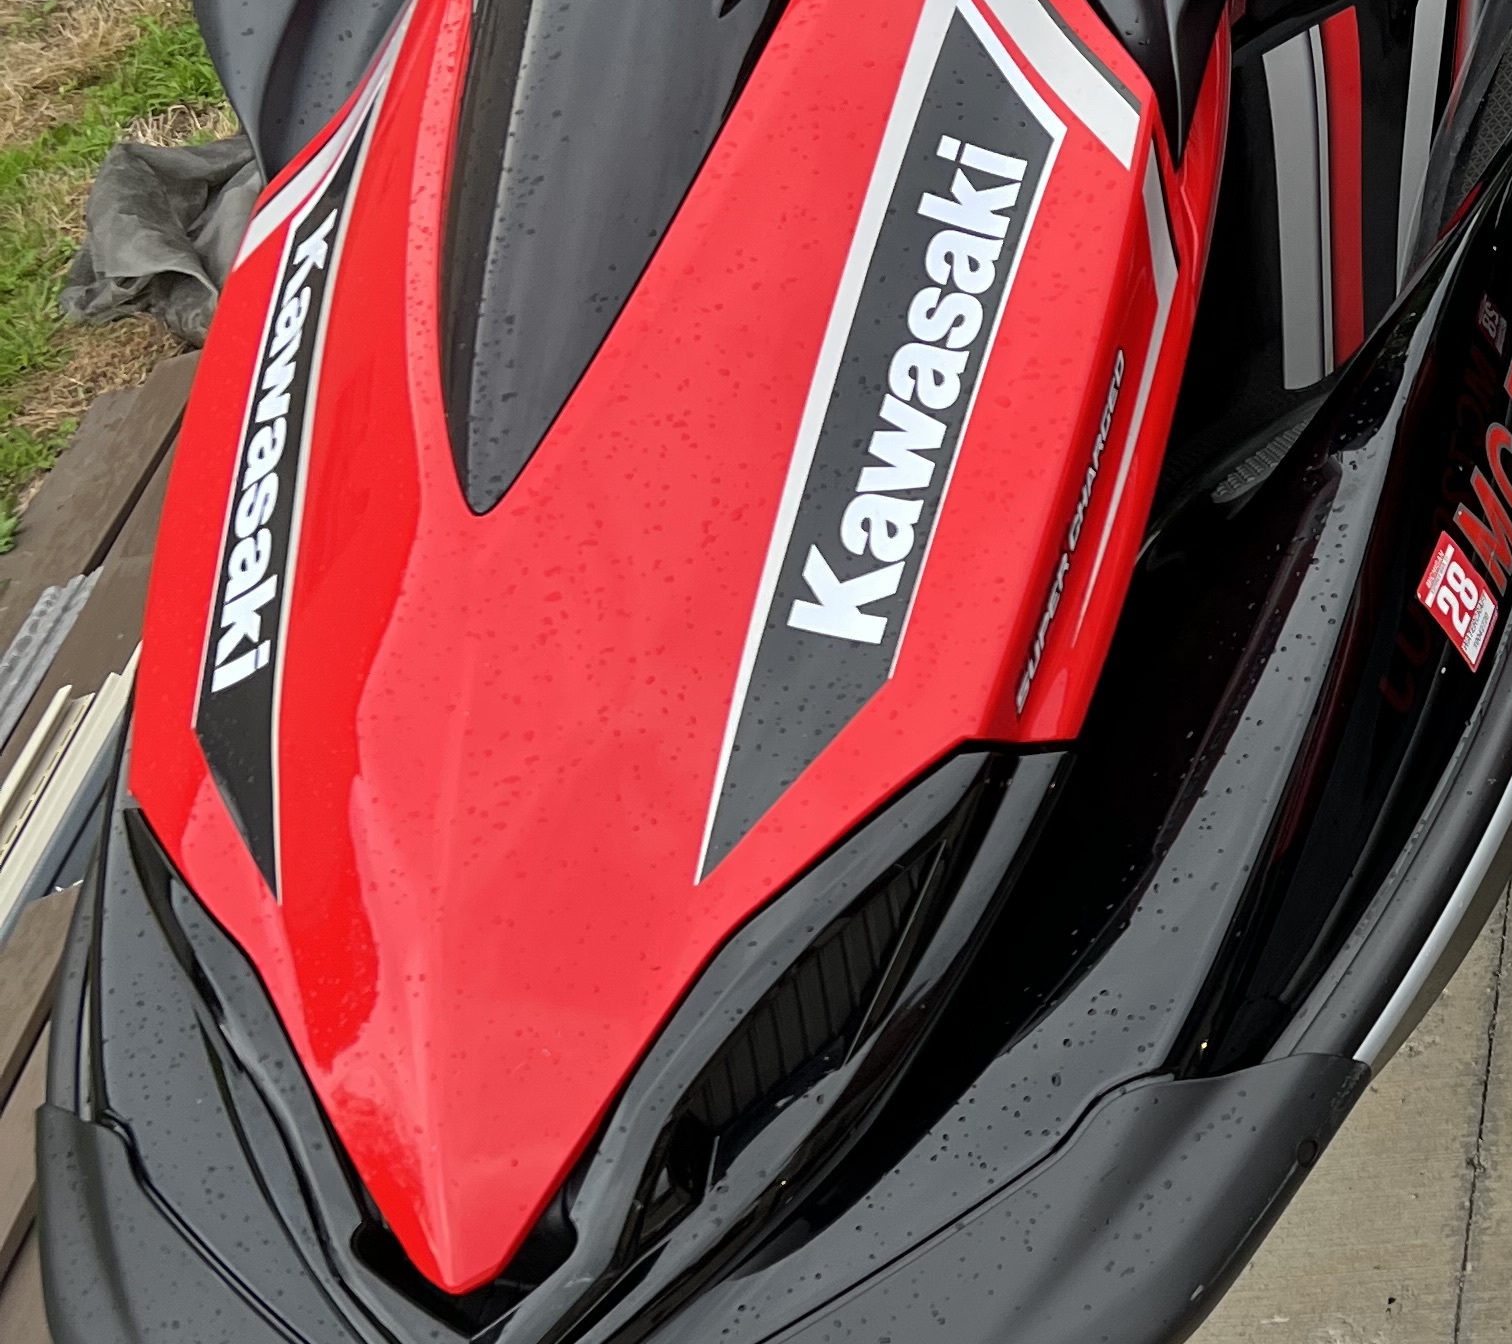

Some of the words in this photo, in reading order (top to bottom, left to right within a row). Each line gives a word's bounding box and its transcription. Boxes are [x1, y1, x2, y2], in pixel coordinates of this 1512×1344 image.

[211, 208, 338, 693] Kawasaki
[787, 134, 1028, 644] Kawasaki
[1015, 552, 1070, 715] SUPER
[1068, 348, 1125, 552] CHARGED
[1436, 561, 1479, 639] 28
